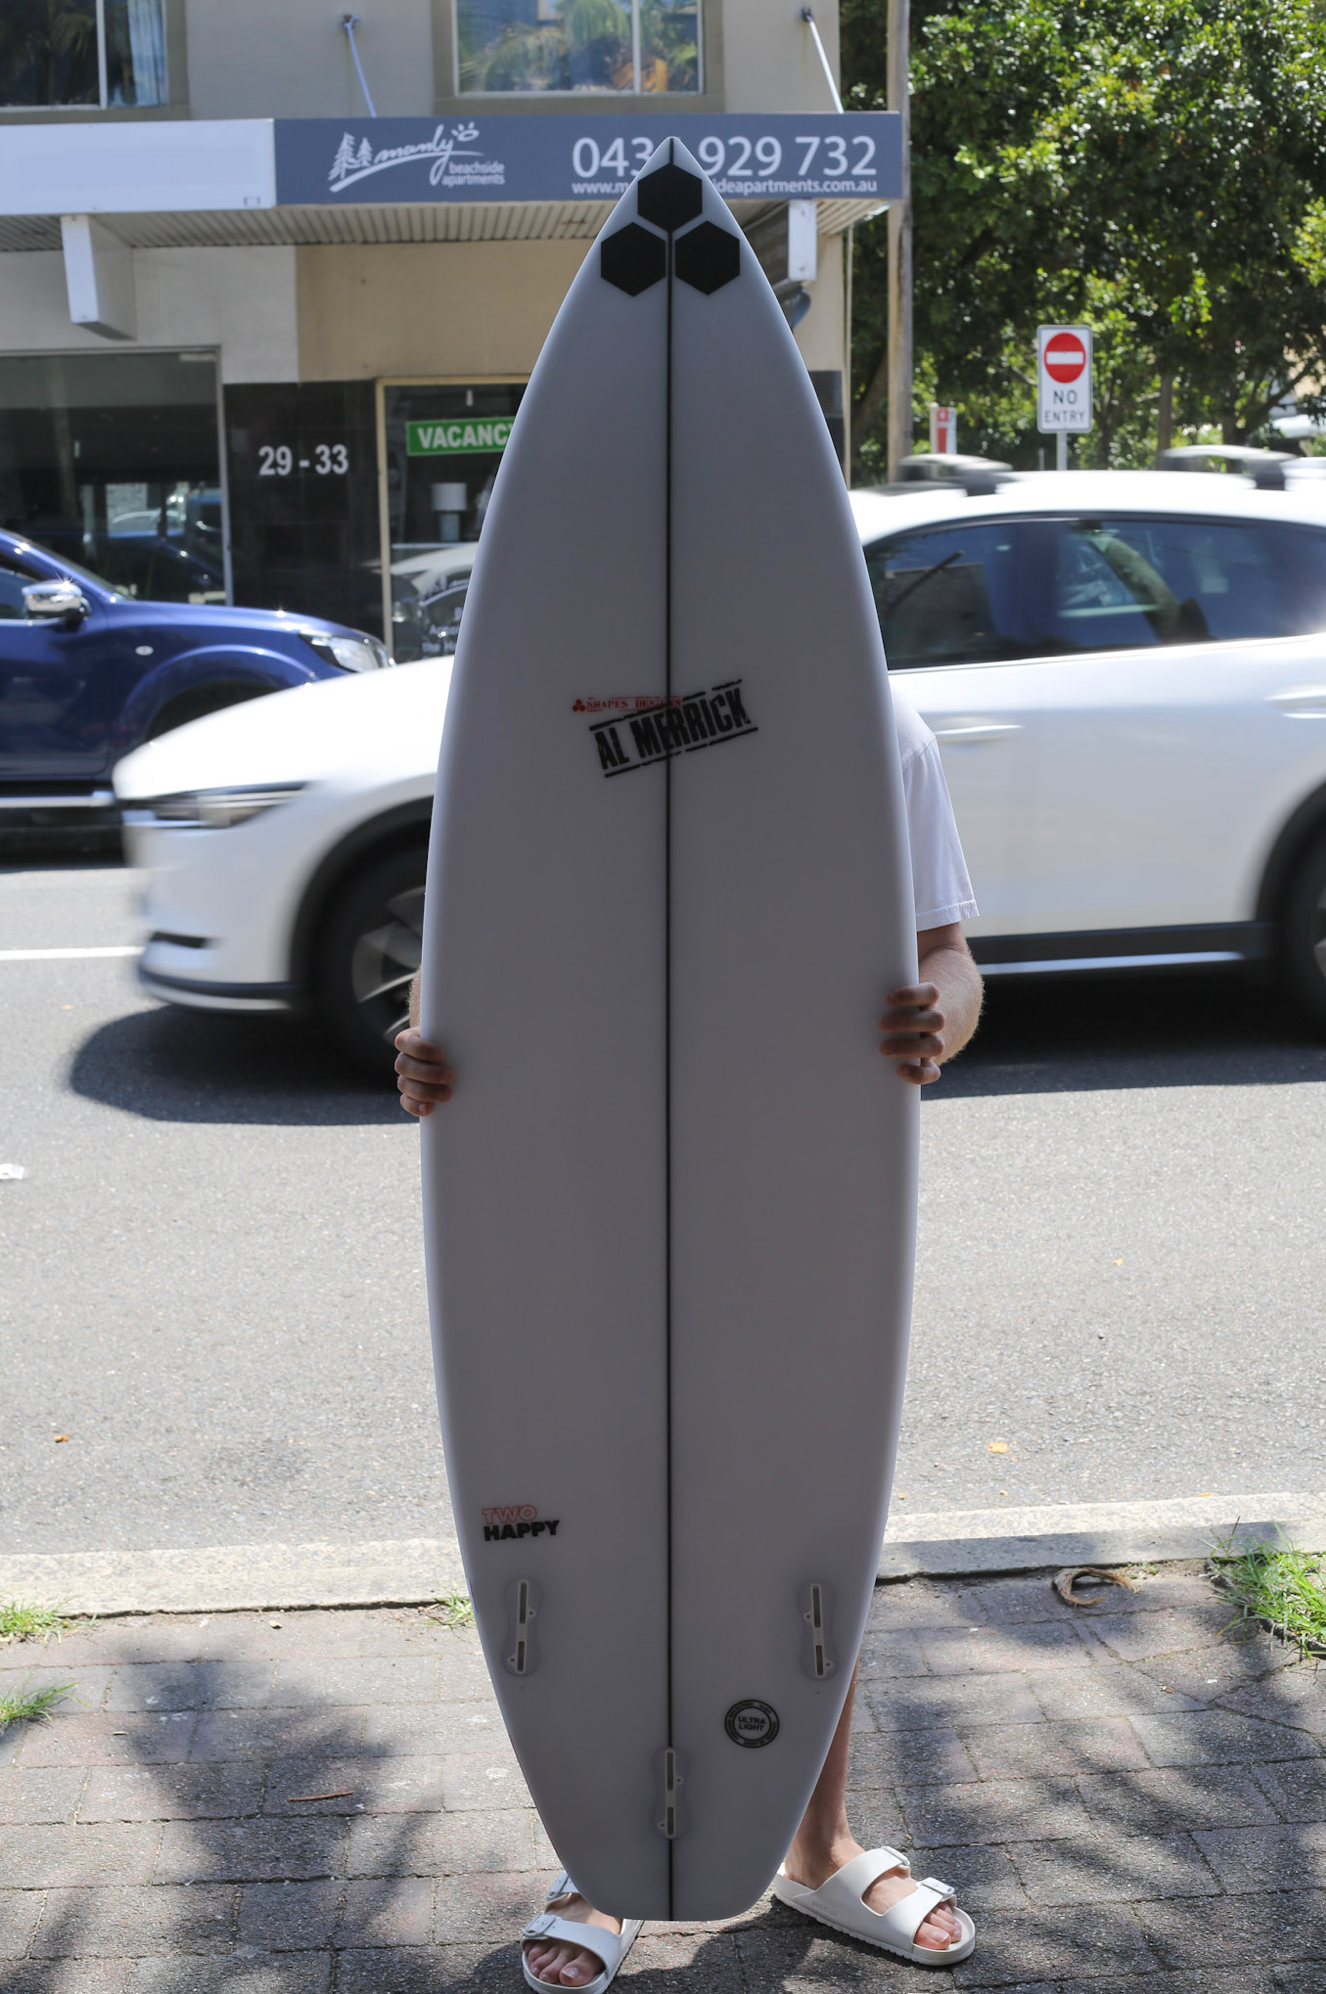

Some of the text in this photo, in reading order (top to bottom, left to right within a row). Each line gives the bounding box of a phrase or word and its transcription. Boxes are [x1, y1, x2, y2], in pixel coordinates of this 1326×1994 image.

[374, 124, 454, 186] manly
[572, 136, 877, 178] 043 929 732
[448, 161, 505, 175] beachside
[441, 174, 506, 188] apartments
[571, 182, 629, 194] www.m
[1053, 389, 1078, 405] NO
[1044, 410, 1086, 424] ENTRY
[417, 422, 515, 450] VACANC
[257, 445, 293, 476] 29
[314, 444, 349, 475] 33
[586, 699, 629, 711] SHAPES
[594, 687, 752, 770] AL MERRICK
[481, 1504, 538, 1525] TWO
[483, 1519, 560, 1541] HAPPY
[737, 1716, 766, 1725] ULTRA
[738, 1724, 765, 1732] LIGHT
